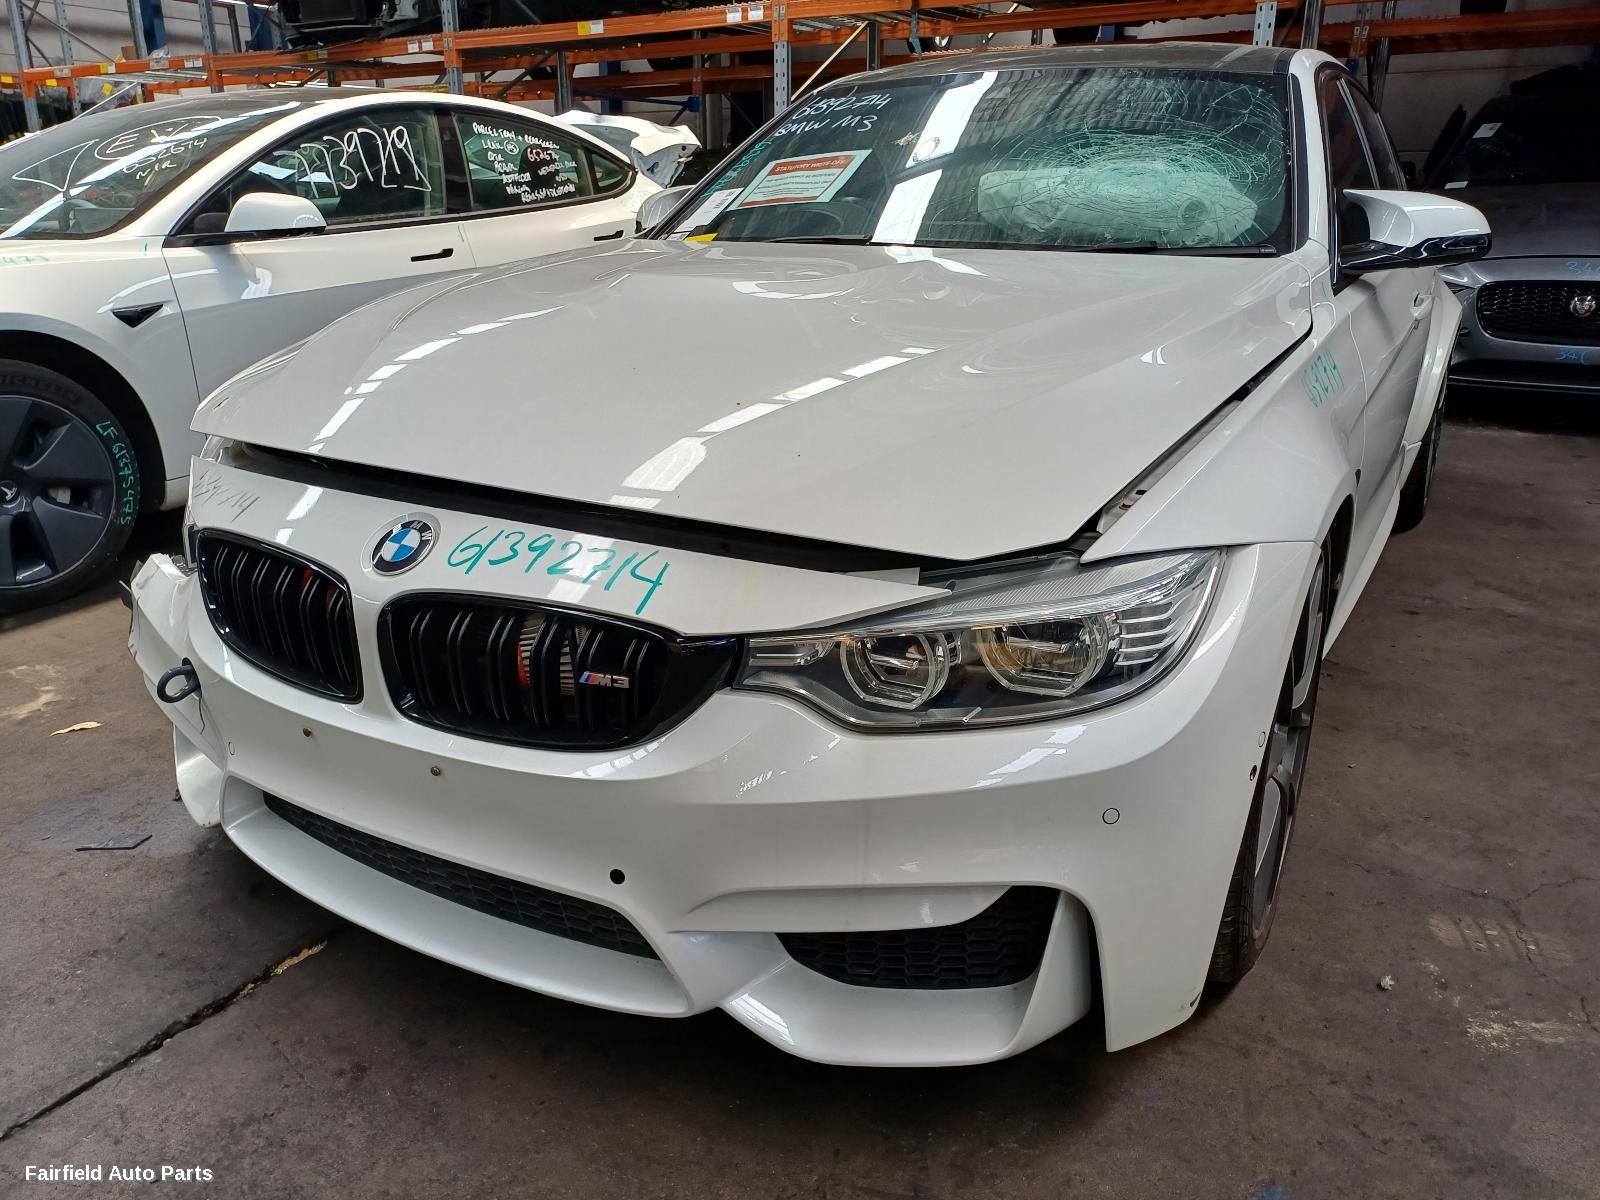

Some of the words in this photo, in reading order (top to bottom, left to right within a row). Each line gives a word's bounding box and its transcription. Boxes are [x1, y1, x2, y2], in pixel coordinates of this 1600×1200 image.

[774, 119, 831, 137] BMW
[831, 115, 878, 132] M3
[774, 163, 811, 172] STATUTORY
[95, 421, 119, 440] LF
